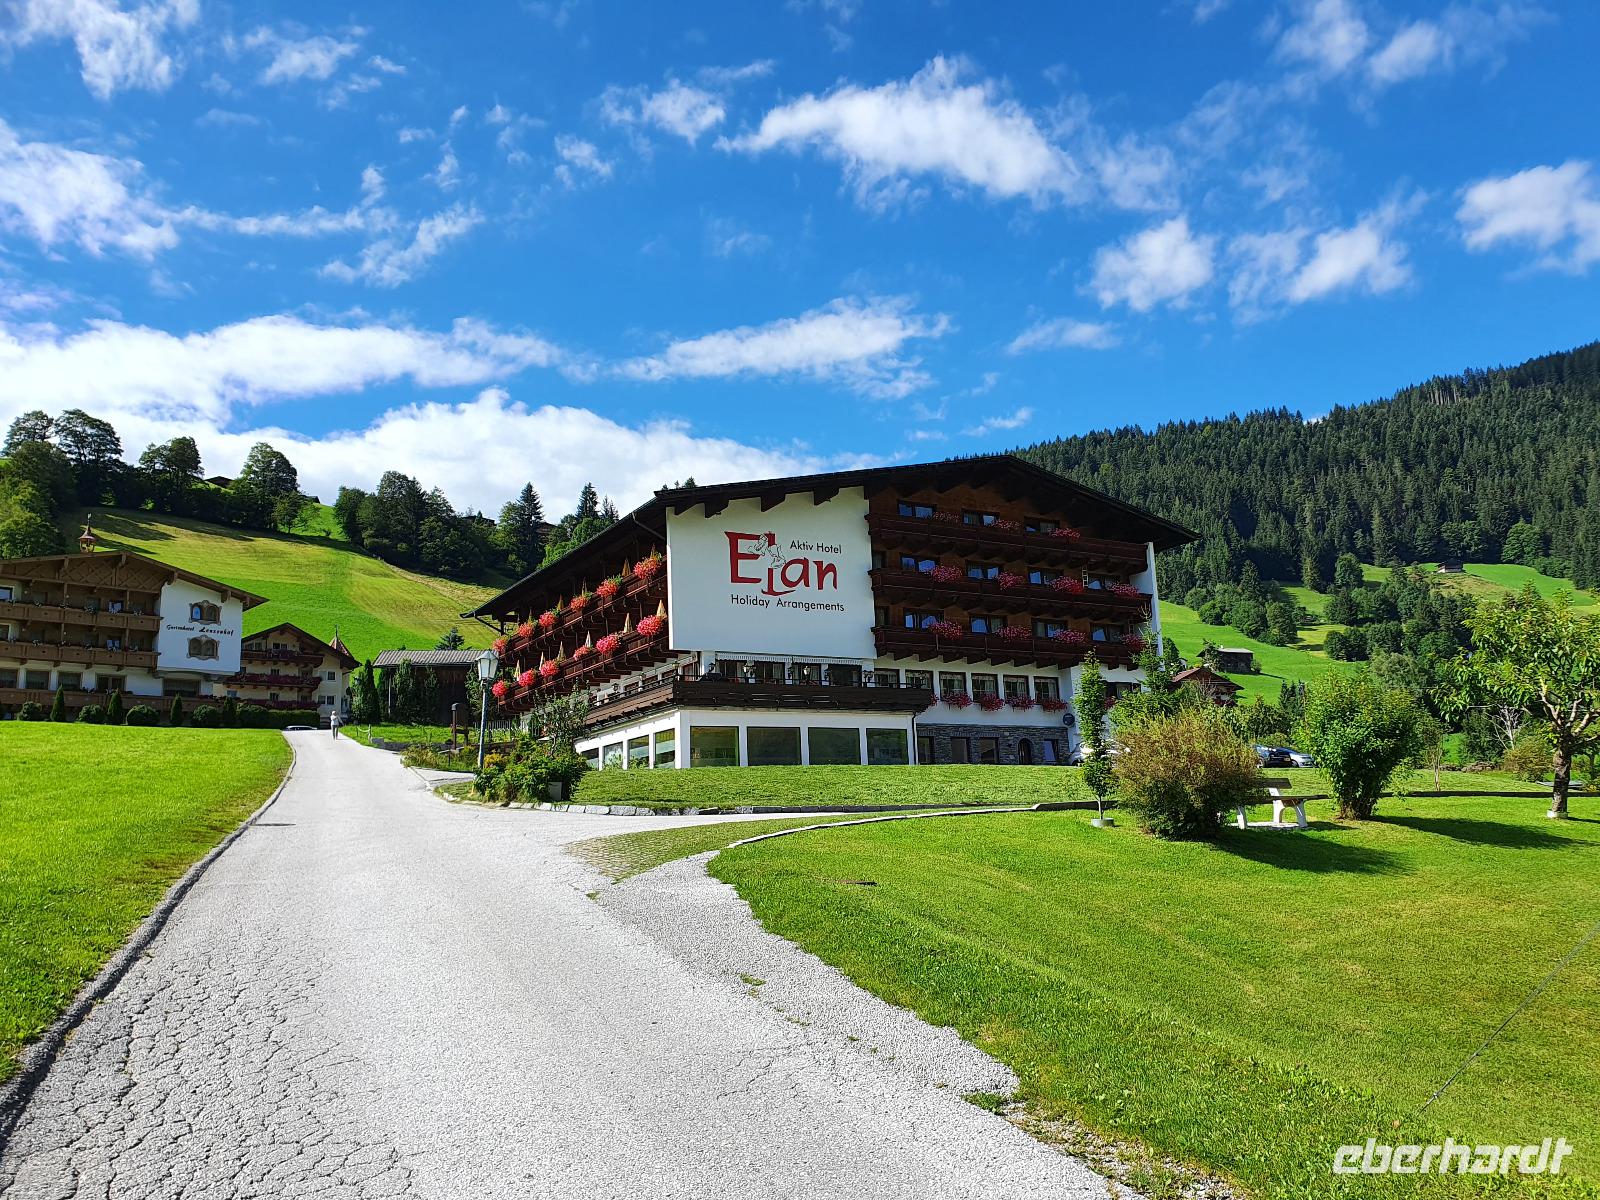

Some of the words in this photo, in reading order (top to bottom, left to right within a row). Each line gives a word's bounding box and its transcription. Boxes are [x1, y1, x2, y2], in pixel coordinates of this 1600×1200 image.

[790, 540, 813, 551] Aktiv
[816, 542, 842, 554] Hotel
[731, 594, 770, 609] Holiday
[776, 598, 844, 611] Arrangements
